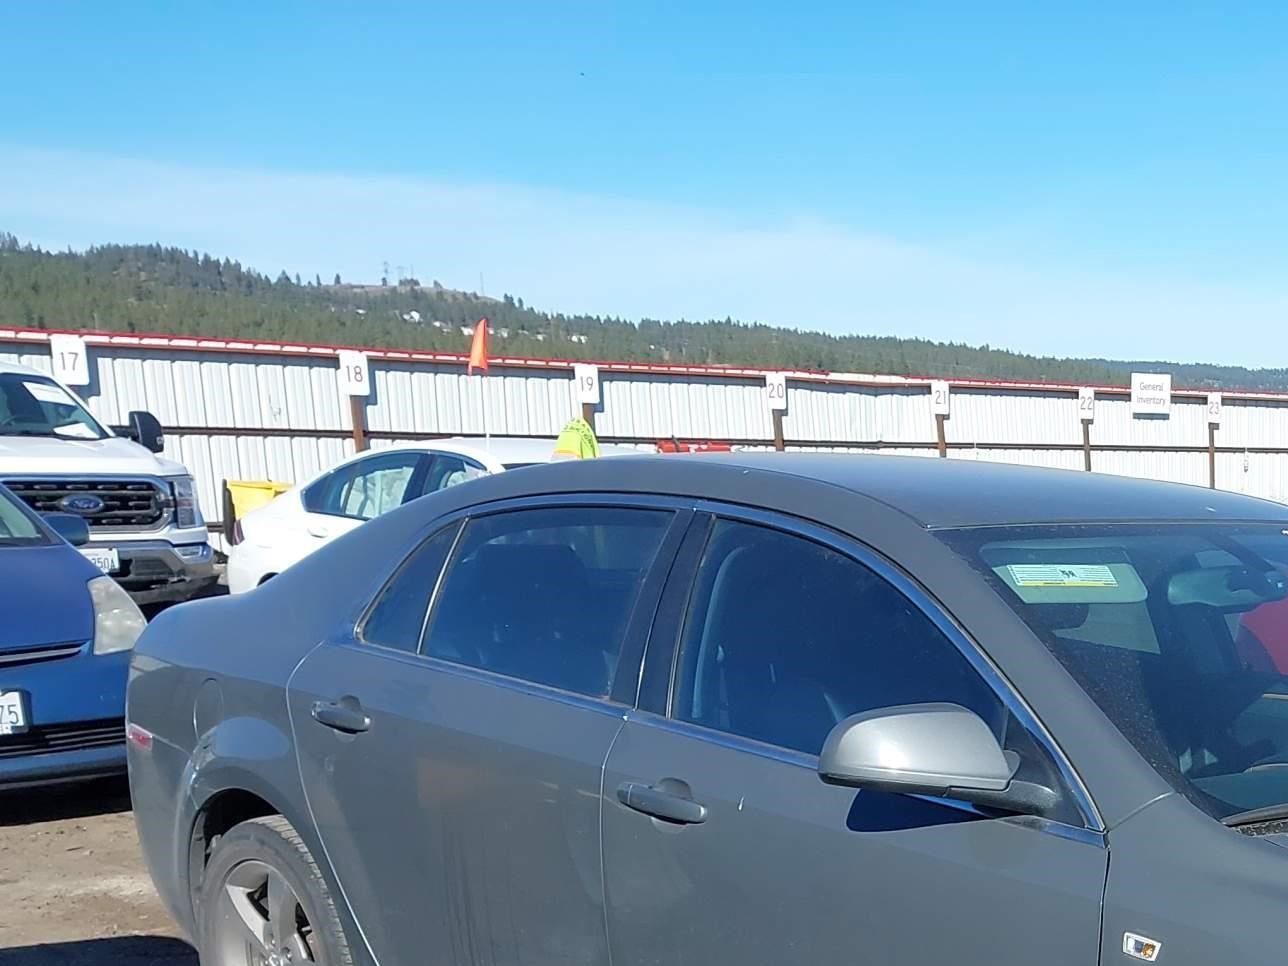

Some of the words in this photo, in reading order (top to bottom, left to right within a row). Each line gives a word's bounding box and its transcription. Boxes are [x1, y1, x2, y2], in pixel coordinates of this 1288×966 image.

[60, 351, 79, 371] 17
[346, 365, 363, 383] 18
[580, 376, 594, 392] 19
[768, 382, 785, 399] 20
[1139, 382, 1164, 391] General
[935, 390, 946, 405] 21
[1080, 396, 1093, 410] 22
[1136, 395, 1166, 406] Inventory
[1208, 401, 1220, 415] 23
